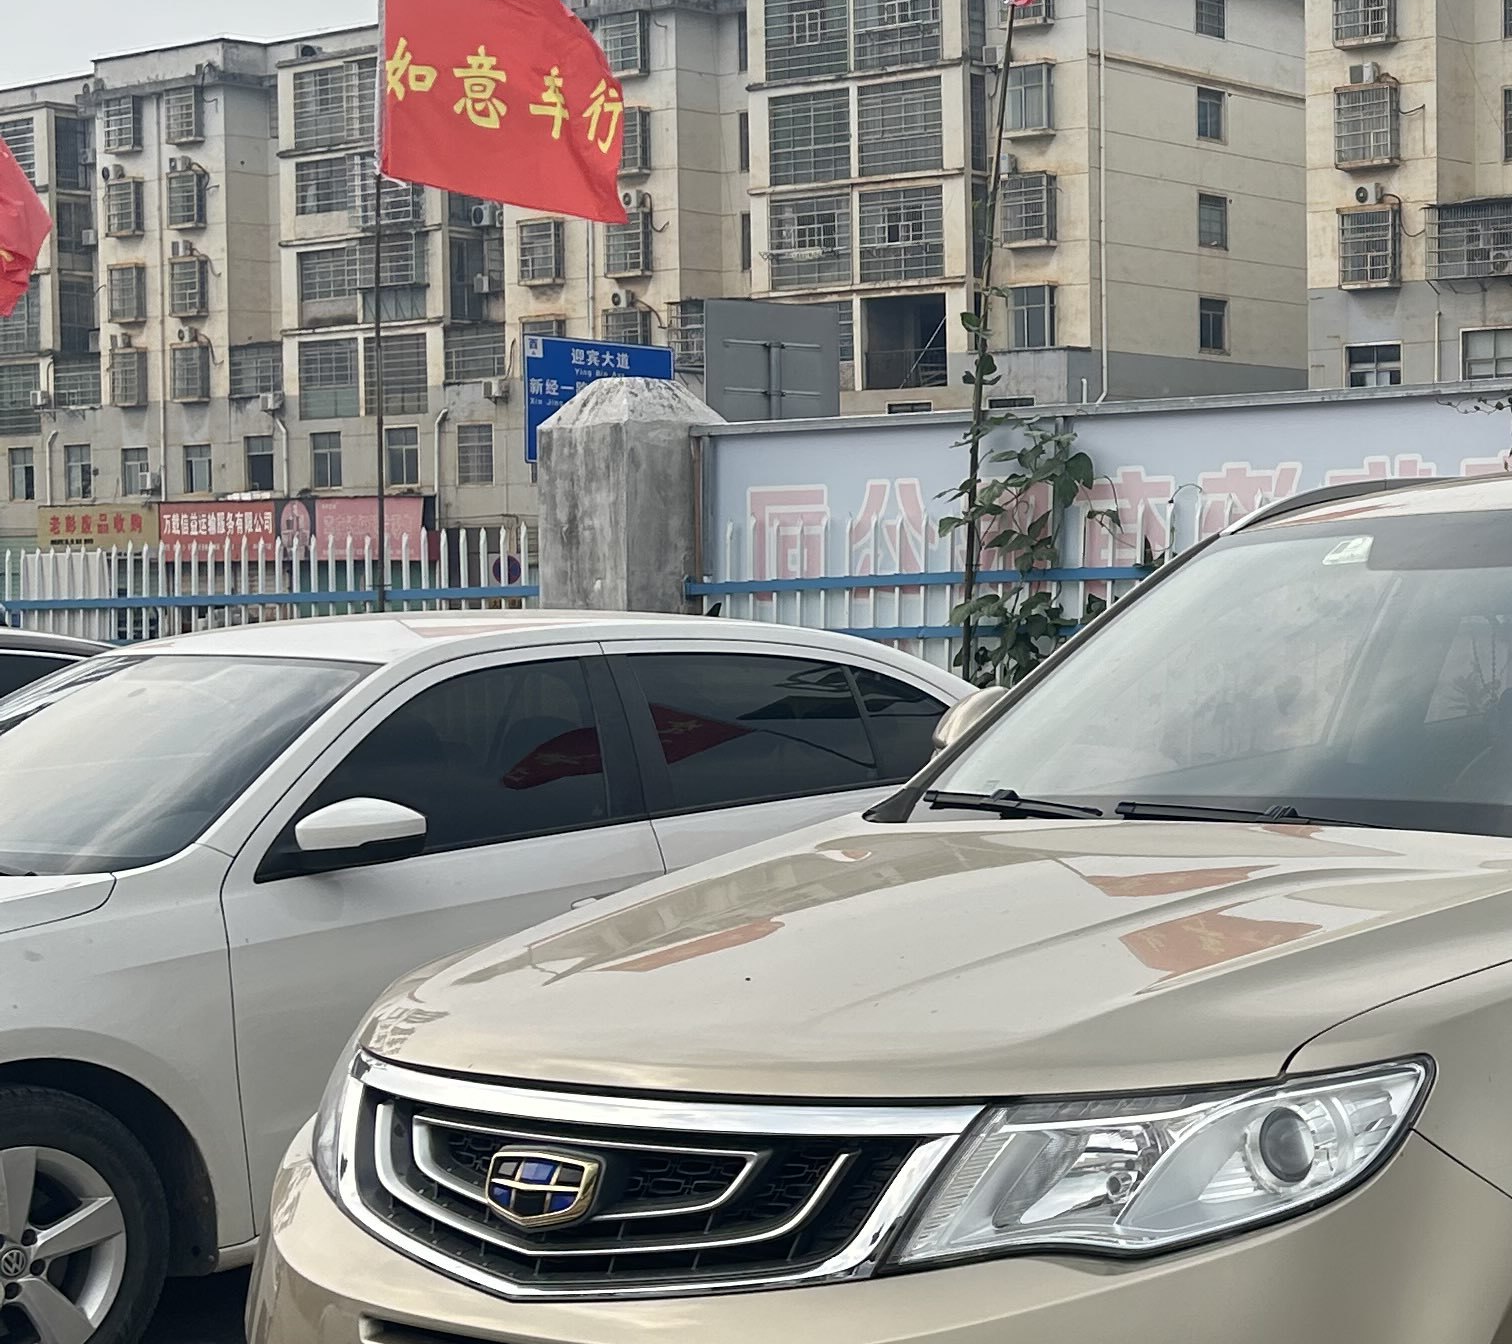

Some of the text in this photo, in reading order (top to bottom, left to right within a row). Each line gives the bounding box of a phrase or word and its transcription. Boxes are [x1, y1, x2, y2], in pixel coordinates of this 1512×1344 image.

[385, 36, 625, 153] 如意车行
[571, 348, 630, 369] 迎宾大道
[574, 368, 592, 377] Ying
[530, 397, 543, 405] Xin
